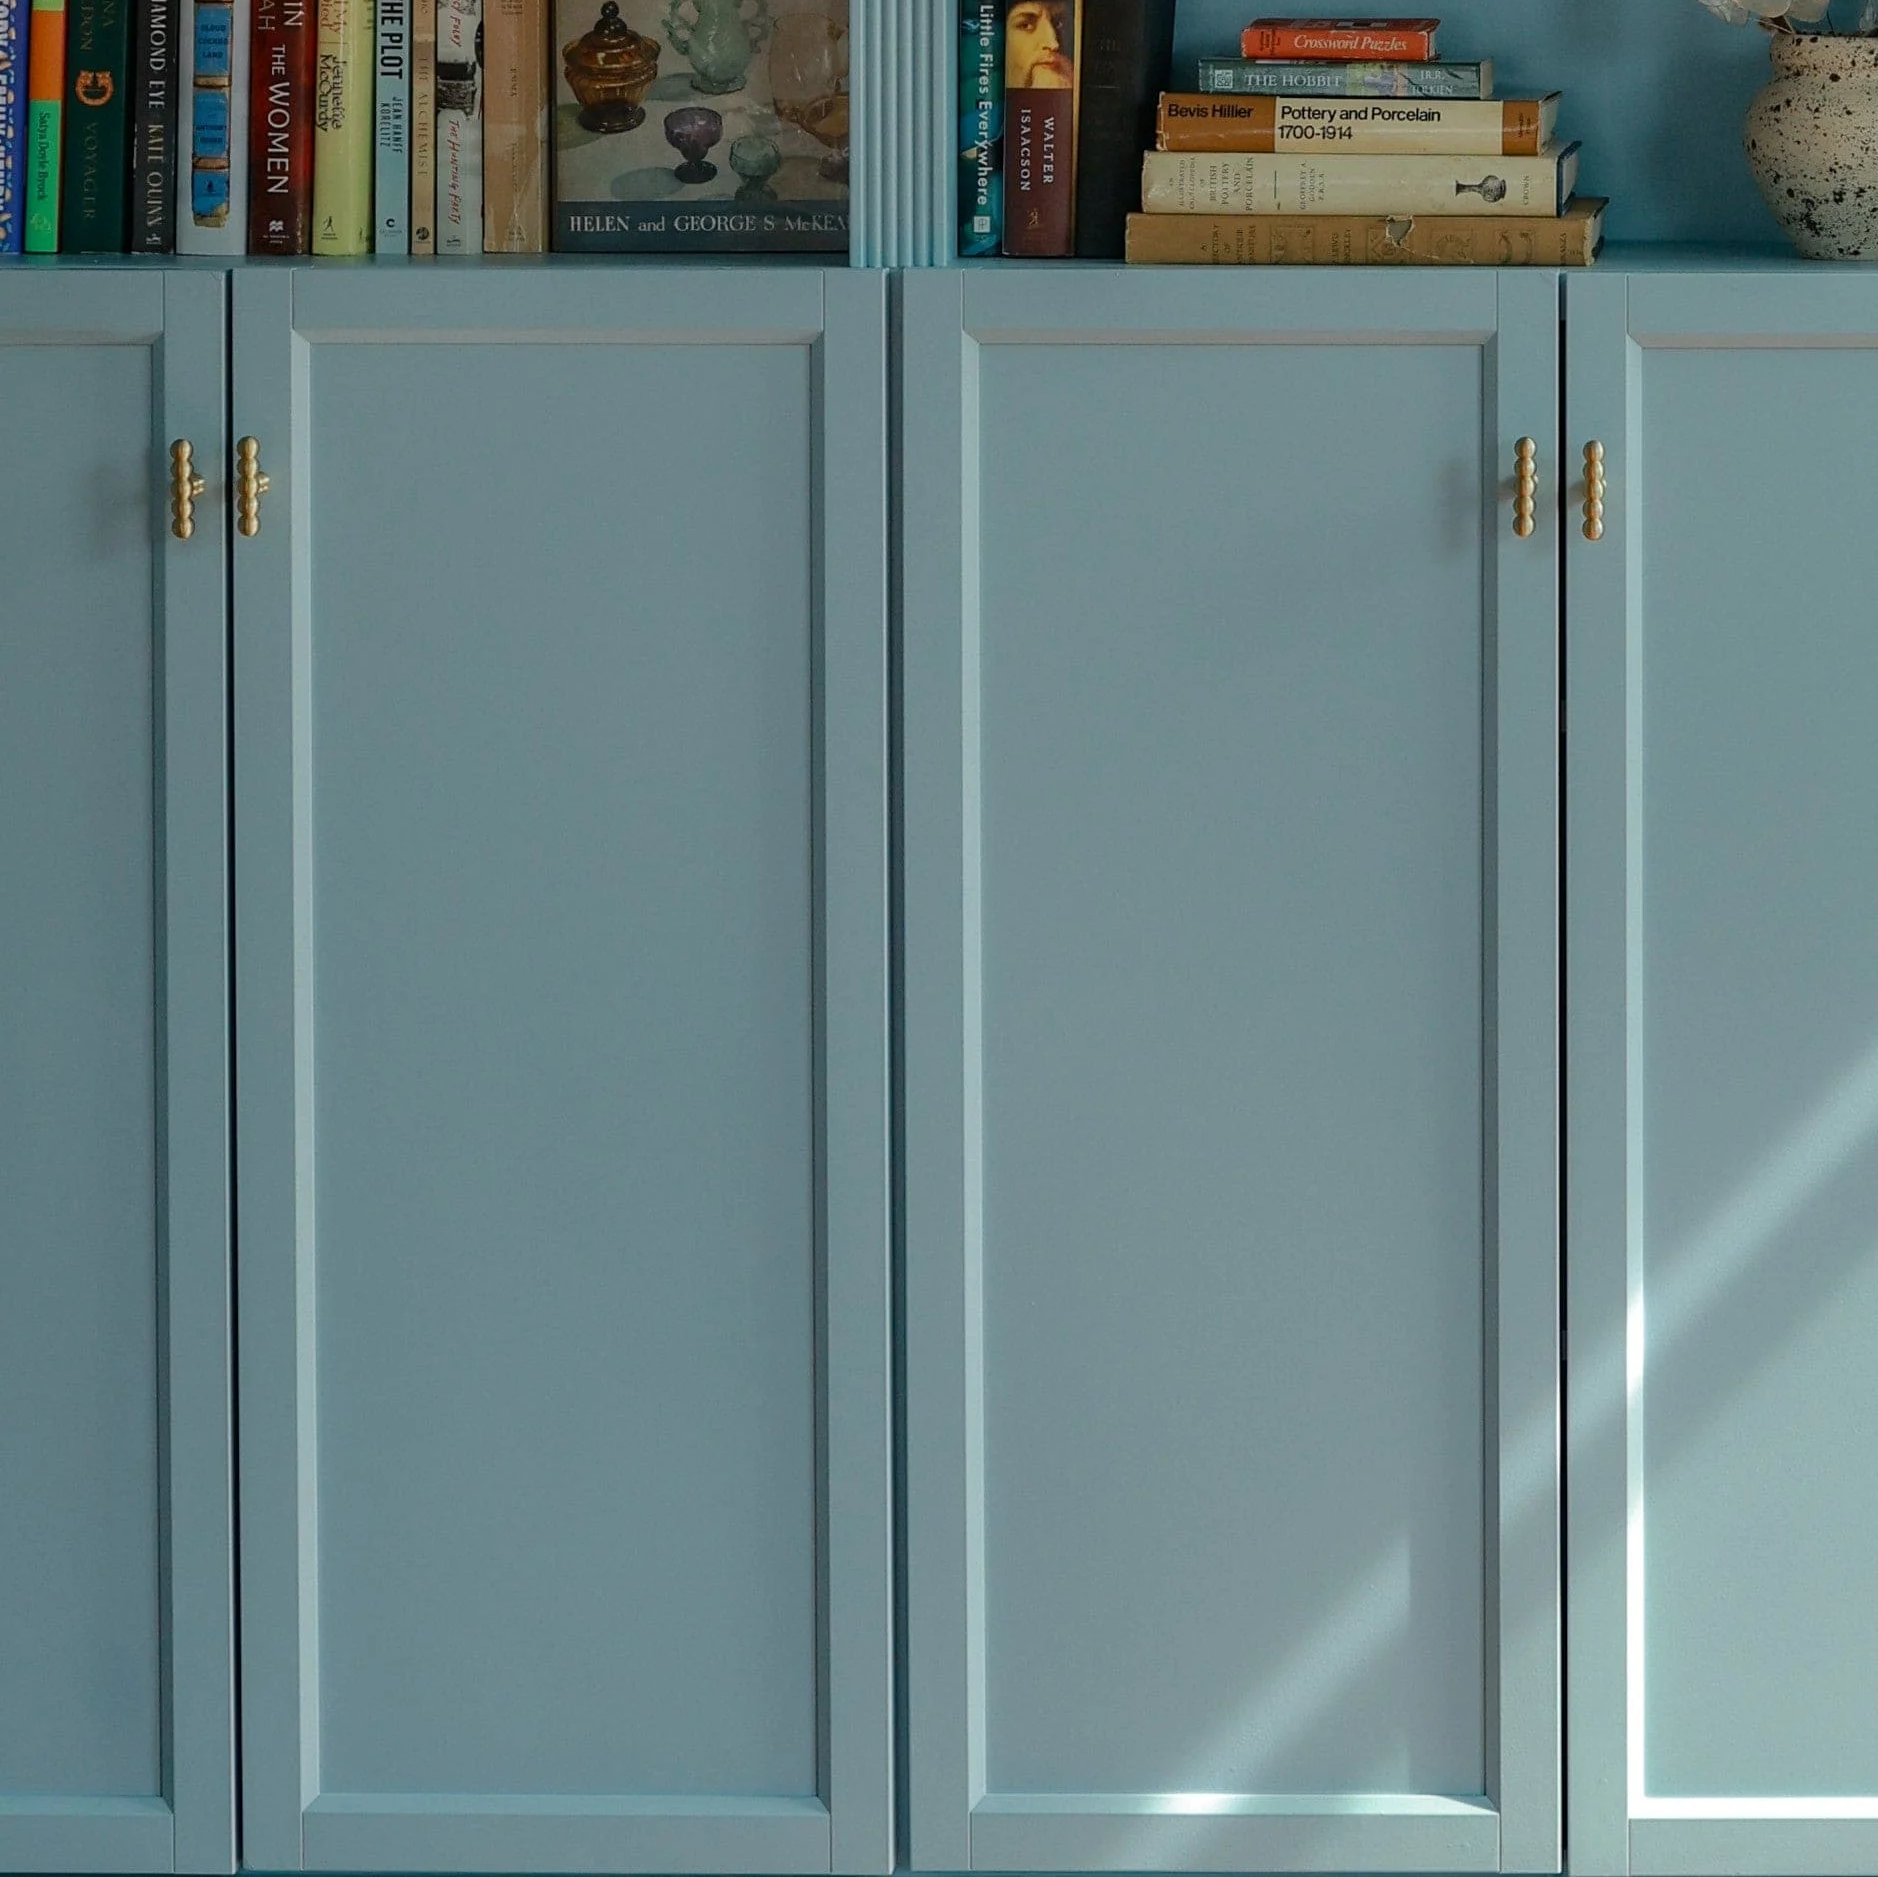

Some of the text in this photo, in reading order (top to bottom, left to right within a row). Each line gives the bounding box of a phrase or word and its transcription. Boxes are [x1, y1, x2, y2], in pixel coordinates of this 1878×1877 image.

[978, 4, 995, 46] Little
[380, 33, 403, 80] PLOT
[977, 53, 994, 95] Fires
[268, 44, 290, 193] THE WOMEN
[1167, 104, 1253, 119] Bevis Hillier
[1277, 124, 1352, 141] 1700-1914
[1281, 105, 1440, 123] Pottery and Porcelain
[973, 100, 993, 205] Everywhere
[1019, 108, 1032, 191] ISAACSON
[1042, 115, 1055, 184] WALTER
